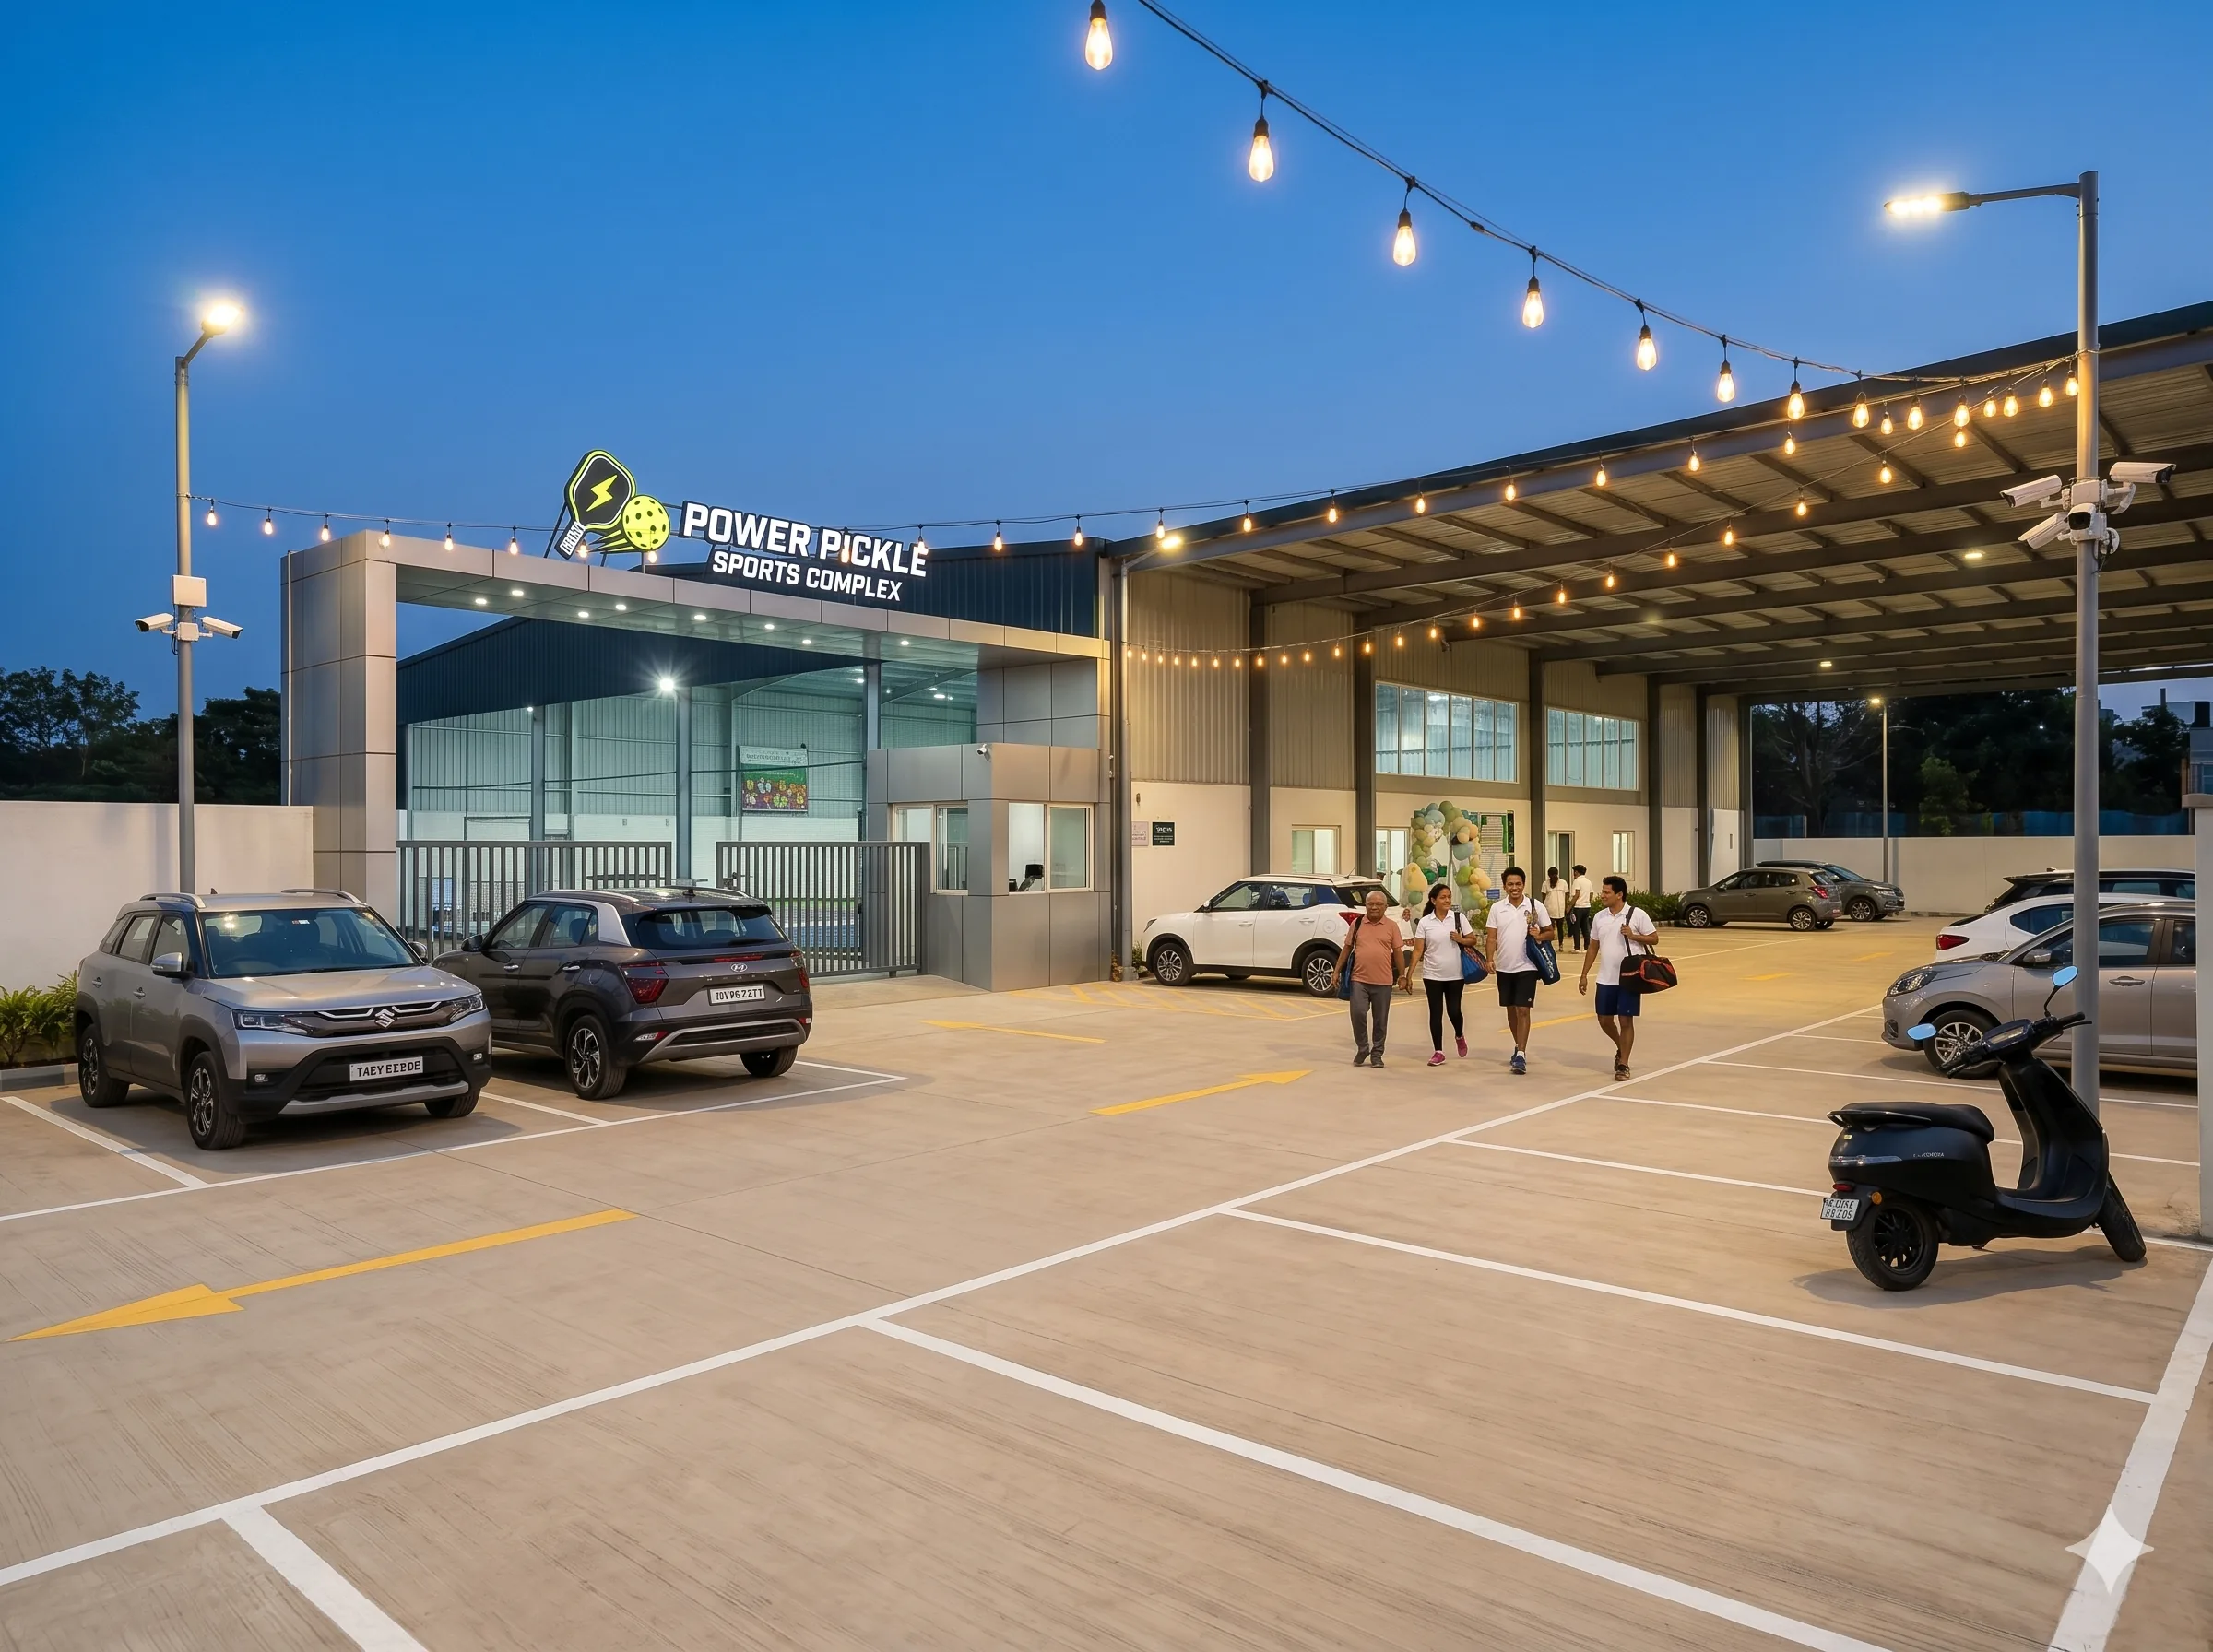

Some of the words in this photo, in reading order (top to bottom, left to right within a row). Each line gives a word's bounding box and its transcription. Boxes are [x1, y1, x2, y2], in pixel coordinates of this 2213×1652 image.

[683, 502, 811, 557] POWER
[821, 528, 929, 578] PICKLE
[712, 550, 799, 585] SPORTS
[806, 567, 901, 601] COMPLEX
